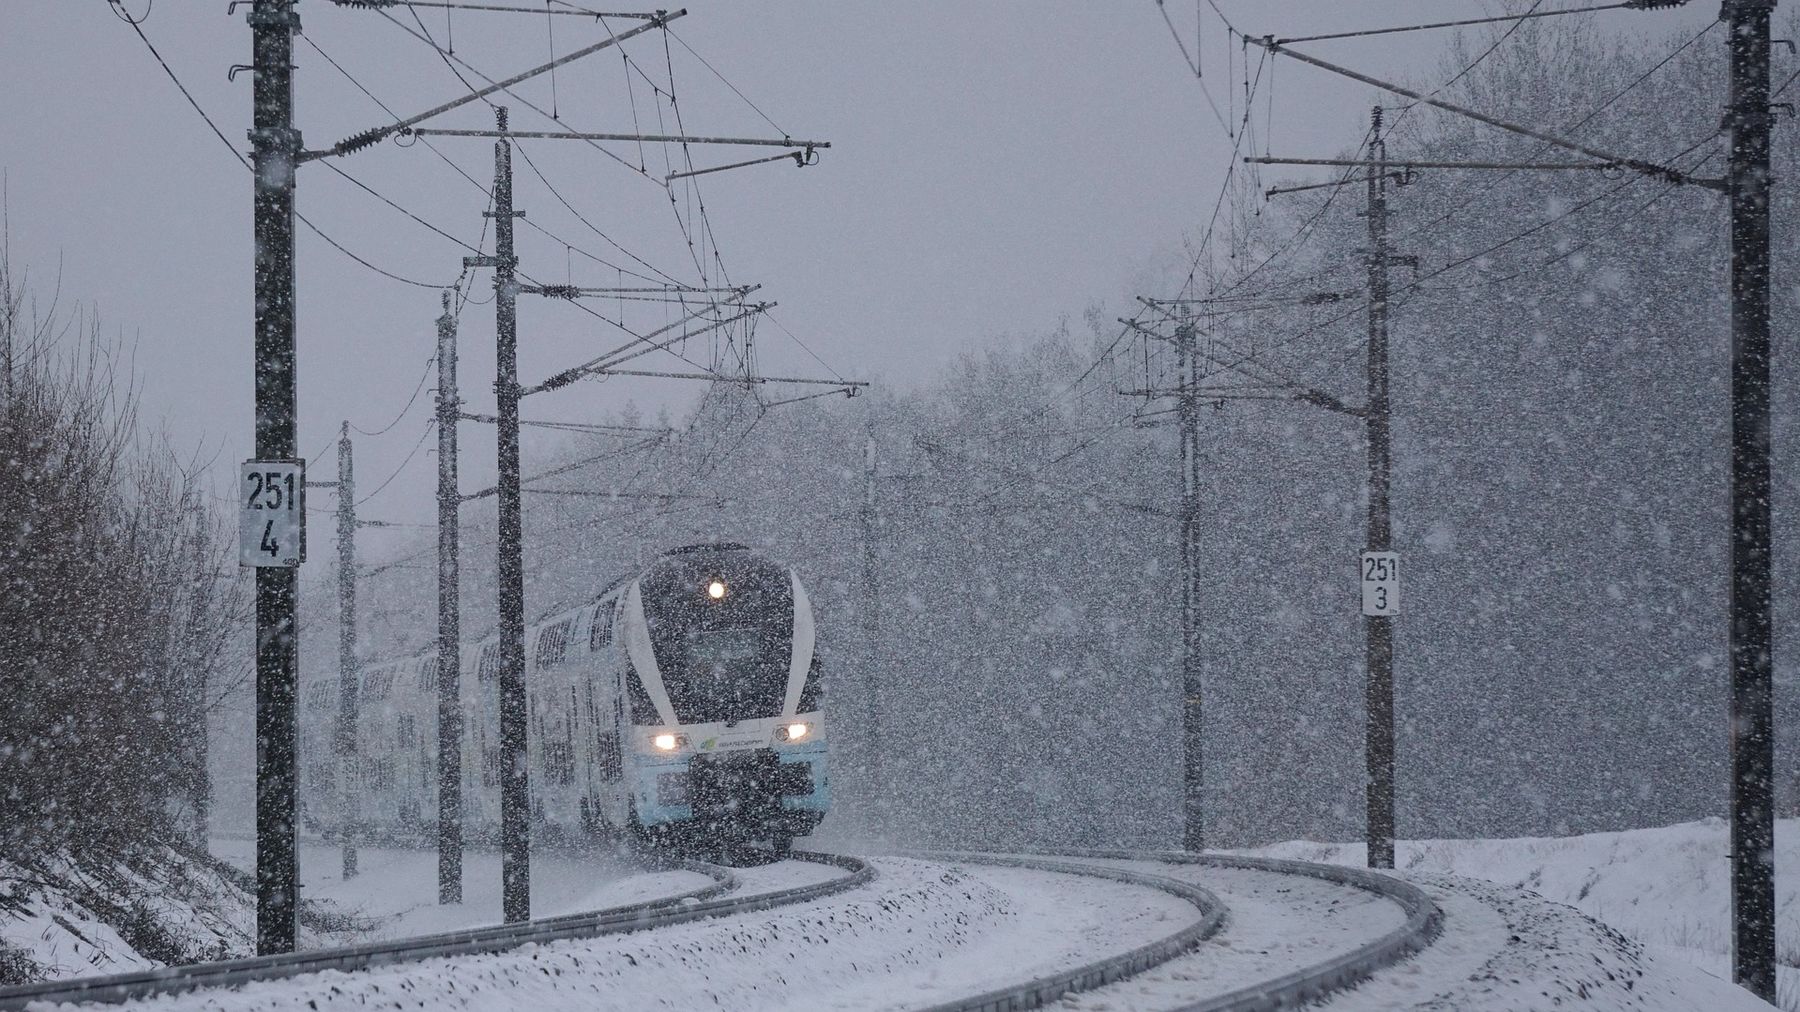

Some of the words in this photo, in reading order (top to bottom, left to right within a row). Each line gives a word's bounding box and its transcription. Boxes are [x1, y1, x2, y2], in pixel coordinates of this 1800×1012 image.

[247, 472, 294, 510] 251
[260, 520, 280, 557] 4
[1365, 557, 1396, 581] 251
[1375, 586, 1387, 610] 3
